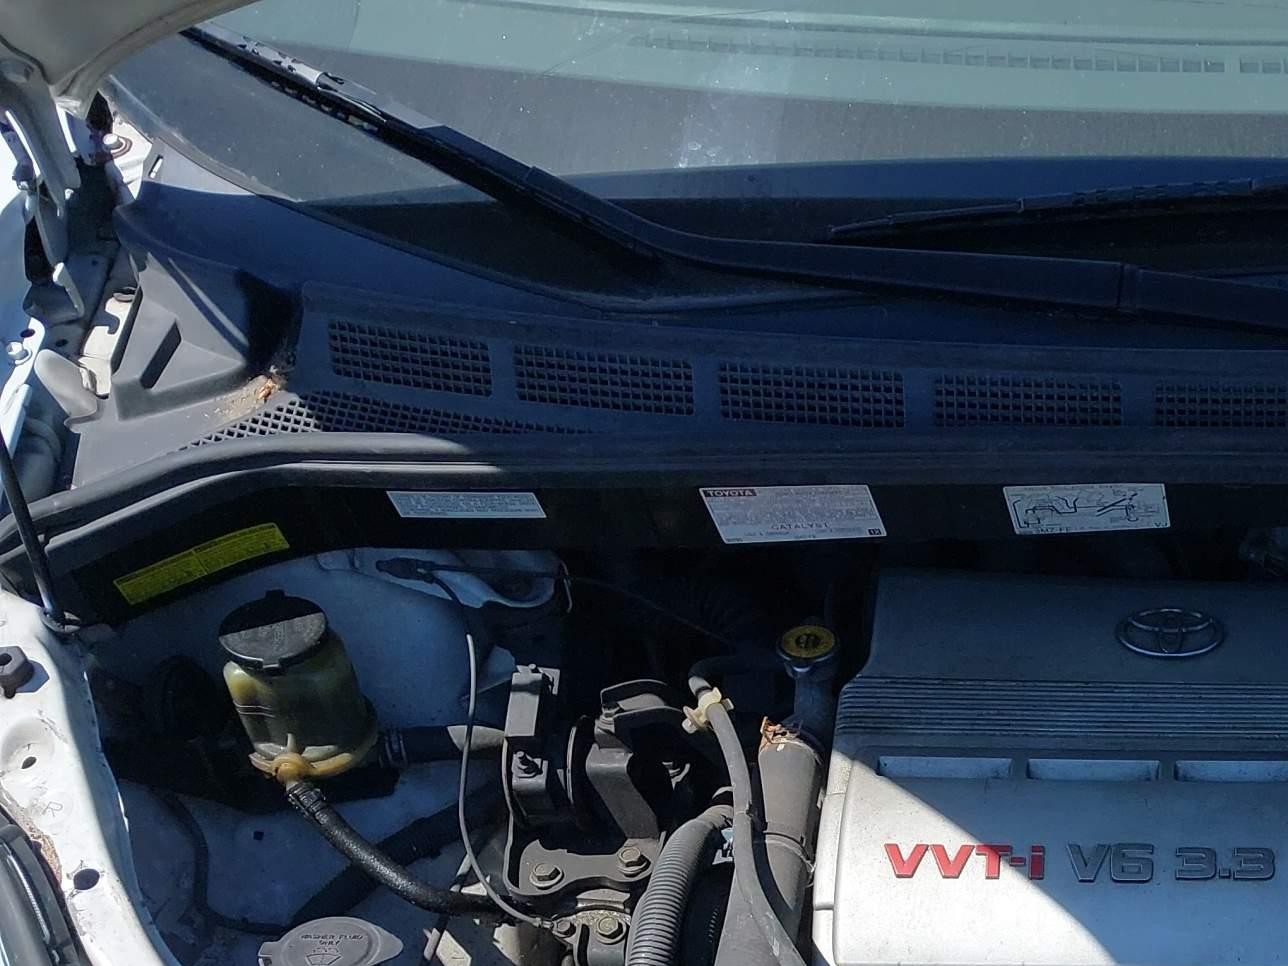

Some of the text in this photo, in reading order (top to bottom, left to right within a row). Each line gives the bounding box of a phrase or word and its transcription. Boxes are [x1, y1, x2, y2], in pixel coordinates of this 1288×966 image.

[884, 843, 1276, 882] VVT-i V6 3.3
